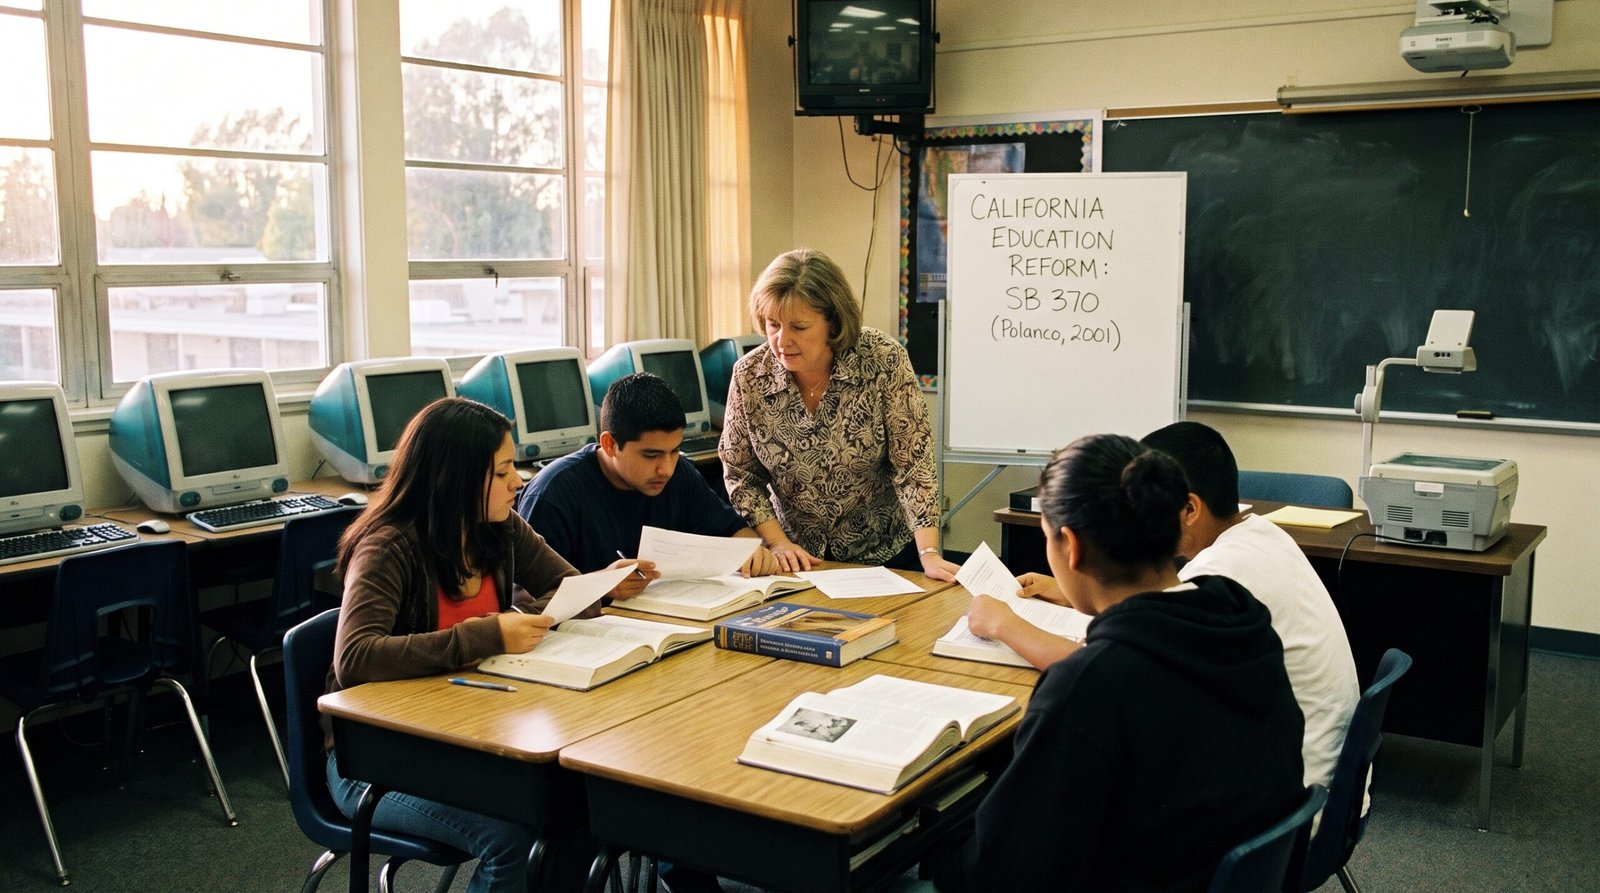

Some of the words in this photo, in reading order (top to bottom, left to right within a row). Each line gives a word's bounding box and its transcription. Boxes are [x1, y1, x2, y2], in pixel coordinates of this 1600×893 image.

[971, 193, 1104, 220] CALIFORNIA
[992, 226, 1114, 250] EDUCATION
[1006, 287, 1041, 311] SB
[1052, 289, 1099, 313] 370
[991, 315, 1065, 345] (Polanco,
[1070, 319, 1121, 352] 2001)
